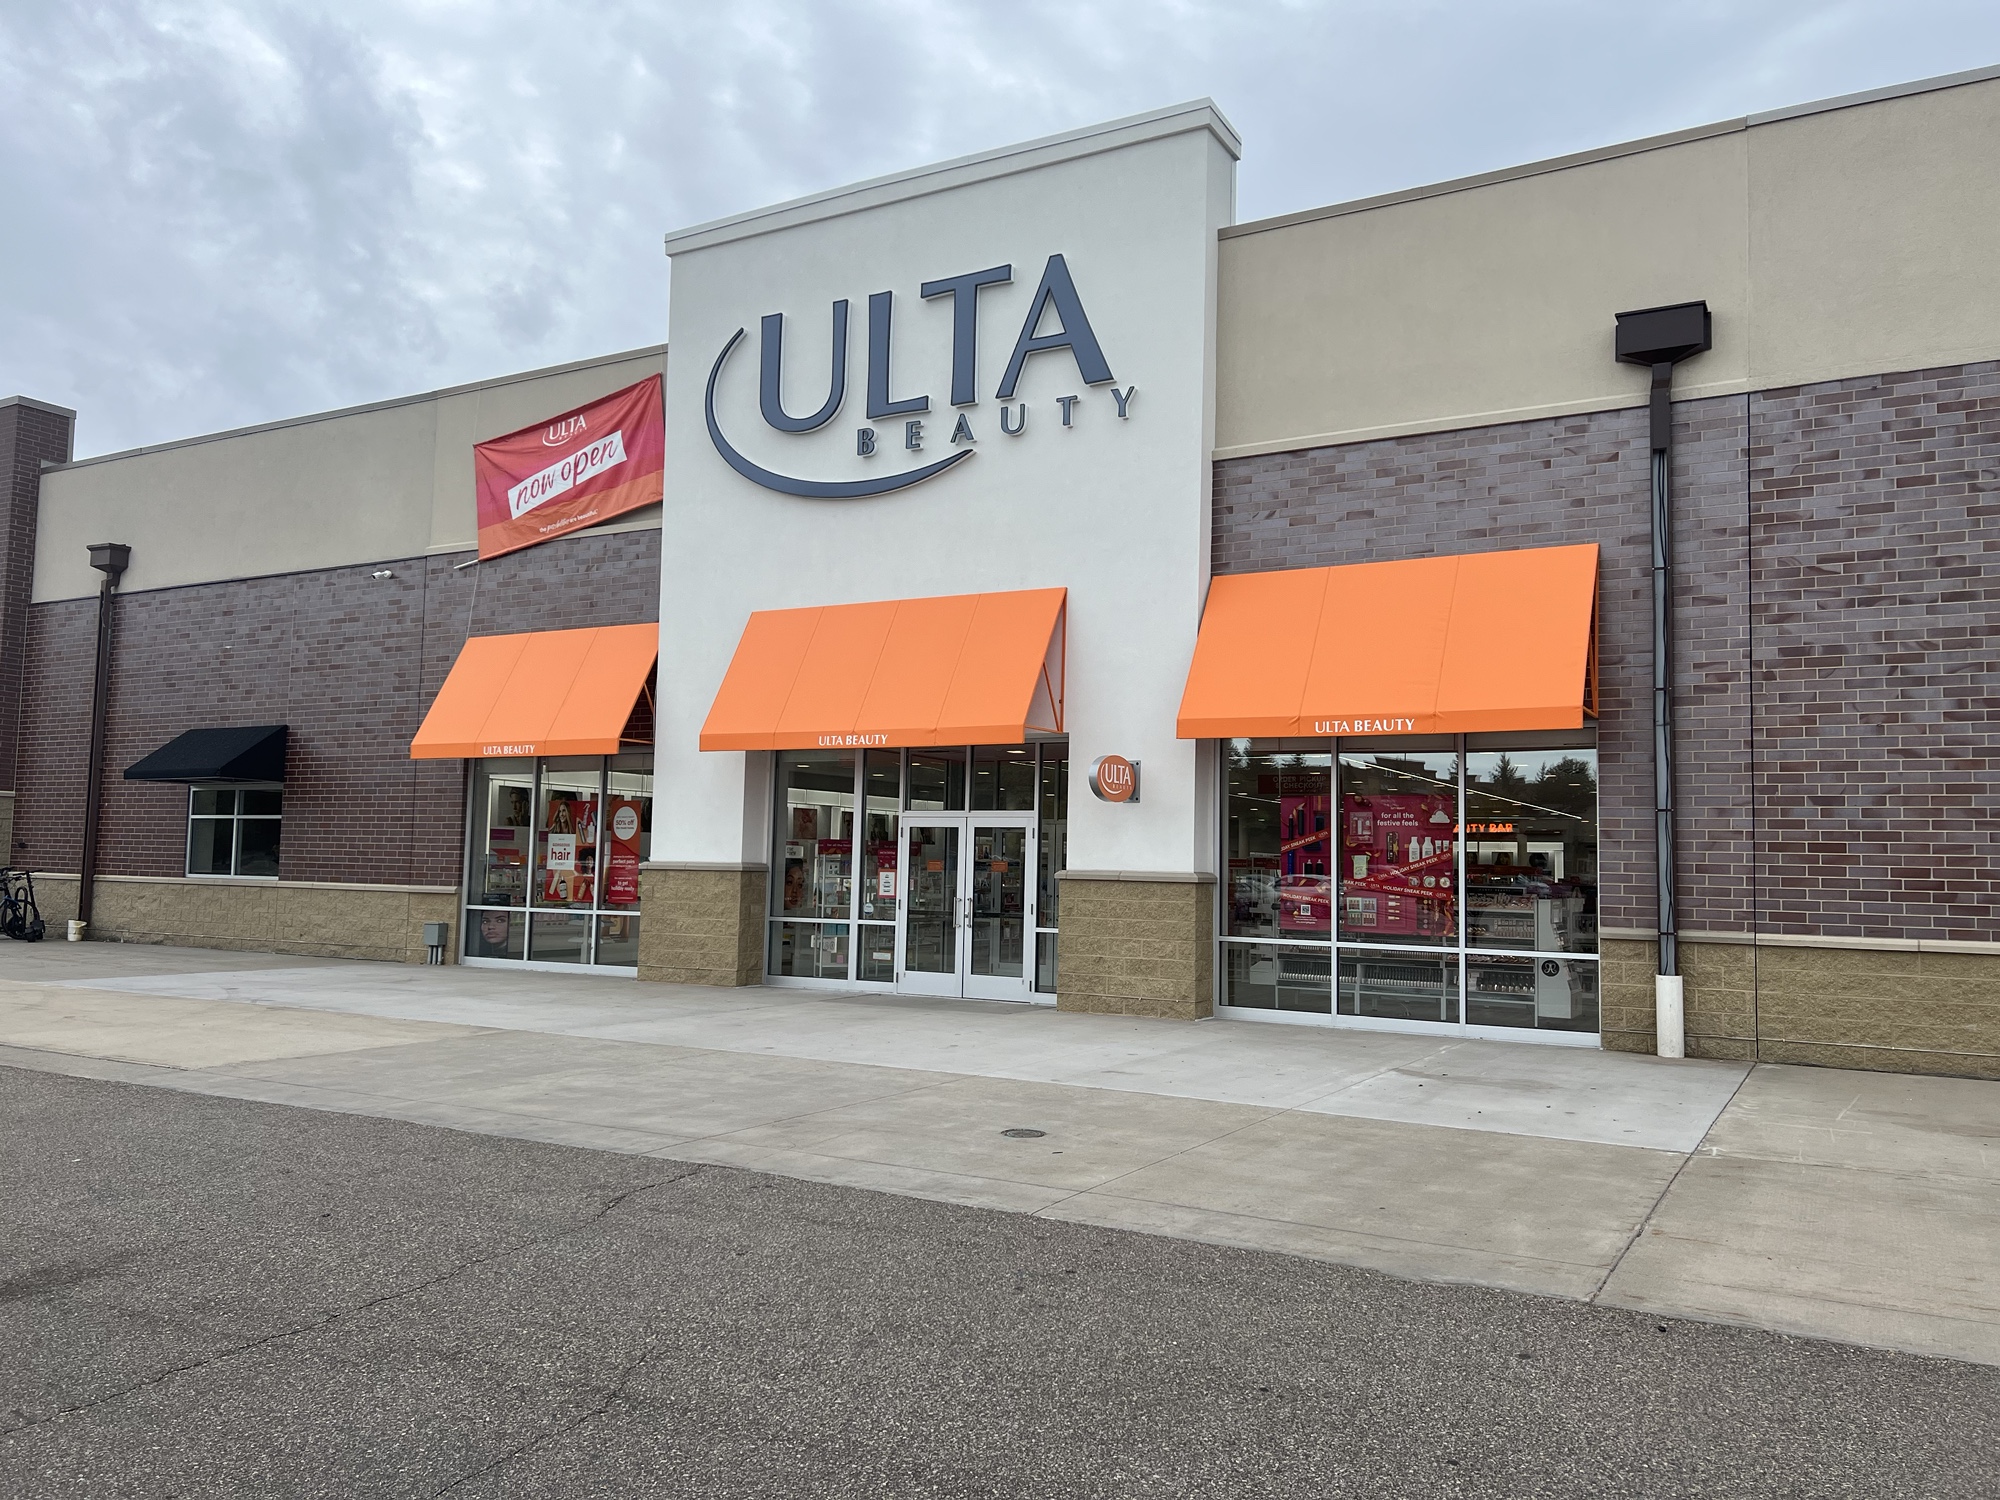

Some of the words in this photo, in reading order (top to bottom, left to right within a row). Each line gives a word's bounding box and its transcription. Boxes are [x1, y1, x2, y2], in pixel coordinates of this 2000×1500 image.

[760, 253, 1116, 434] ULTA
[549, 414, 587, 440] ULTA
[856, 385, 1137, 458] BEAUTY
[516, 469, 556, 510] now
[561, 439, 618, 488] open
[1315, 720, 1350, 733] ULTA
[1354, 718, 1415, 732] BEAUTY
[818, 735, 843, 746] ULTA
[846, 734, 888, 745] BEAUTY
[483, 745, 502, 755] ULTA
[503, 744, 535, 755] BEAUTY
[1105, 763, 1131, 785] ULTA
[1299, 775, 1326, 783] PICKUP
[1489, 823, 1513, 833] BAR
[551, 848, 571, 860] hair
[1390, 865, 1410, 876] HOLIDAY
[1410, 861, 1426, 870] SNEAK
[1426, 857, 1439, 865] PEEK
